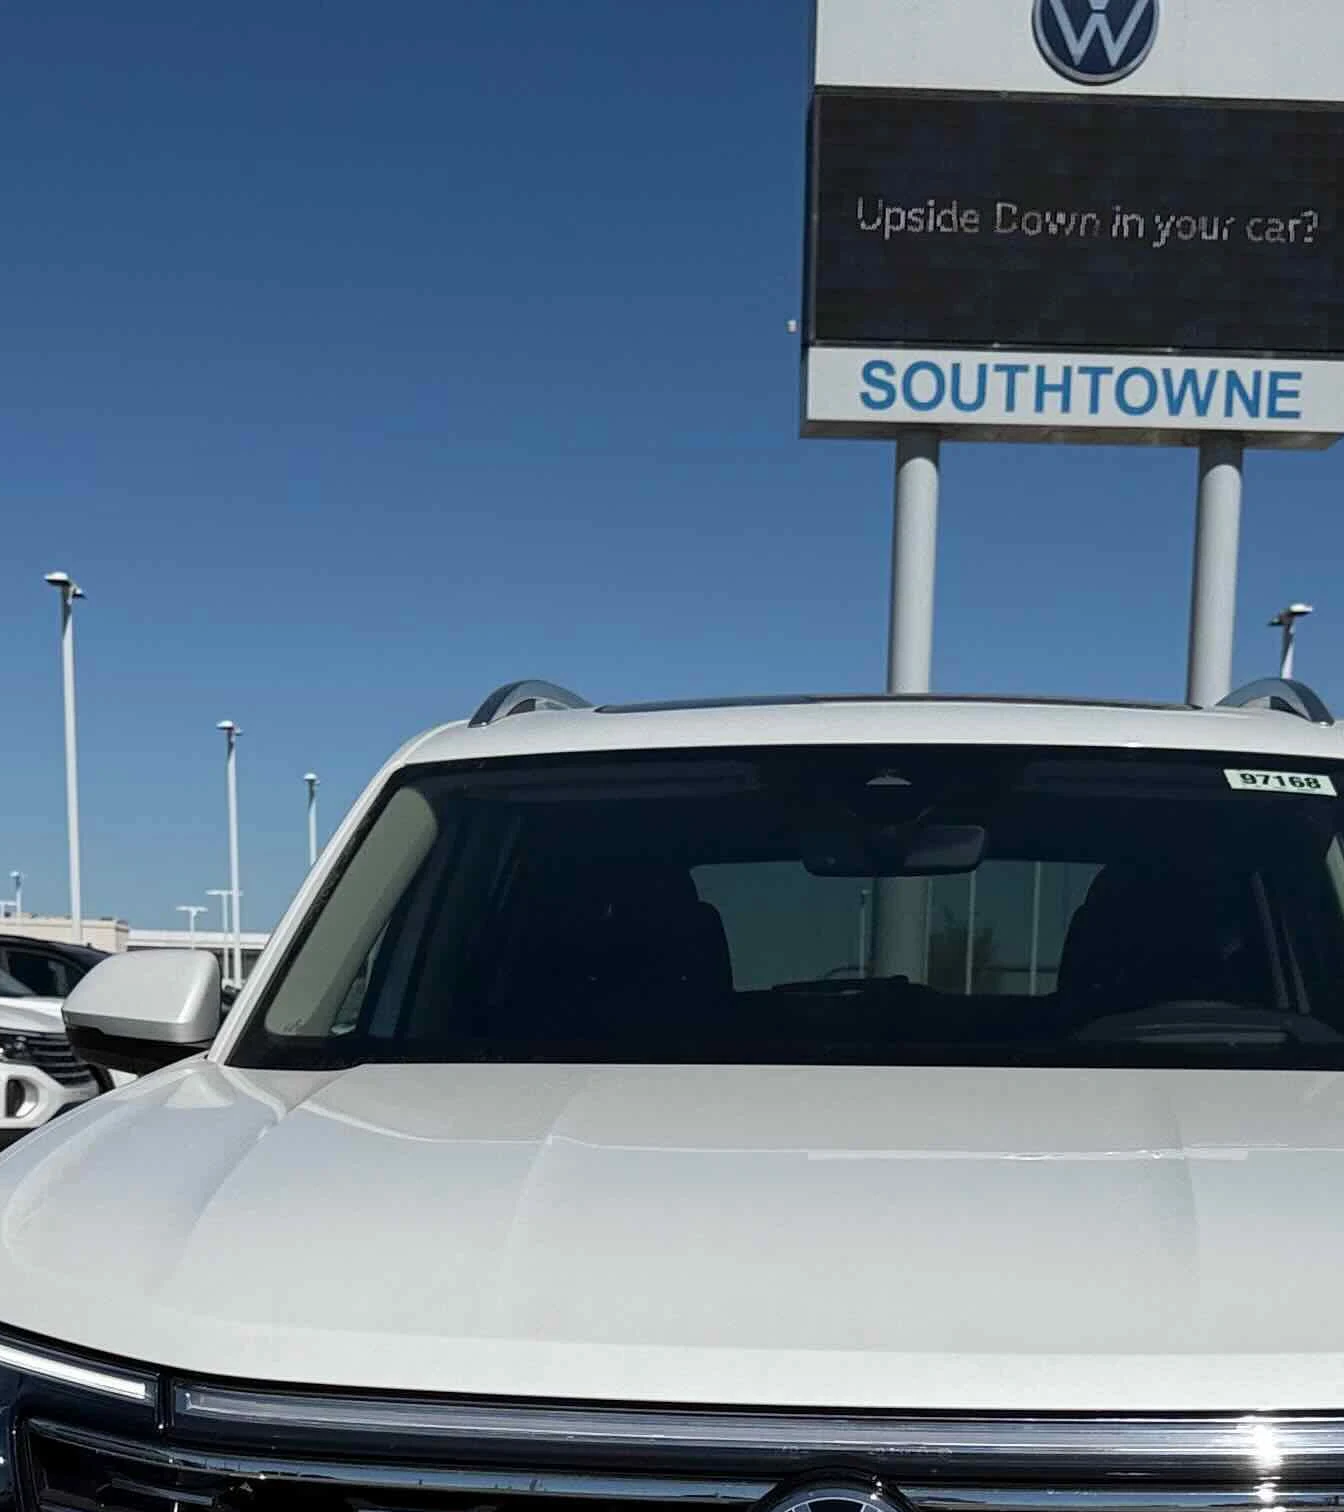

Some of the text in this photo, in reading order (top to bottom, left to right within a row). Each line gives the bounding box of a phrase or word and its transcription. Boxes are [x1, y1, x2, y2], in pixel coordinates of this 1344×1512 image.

[1042, 0, 1154, 71] W
[857, 197, 1318, 248] Upside Down in your car?
[860, 360, 1303, 419] SOUTHTOWNE
[1240, 773, 1321, 789] 97168
